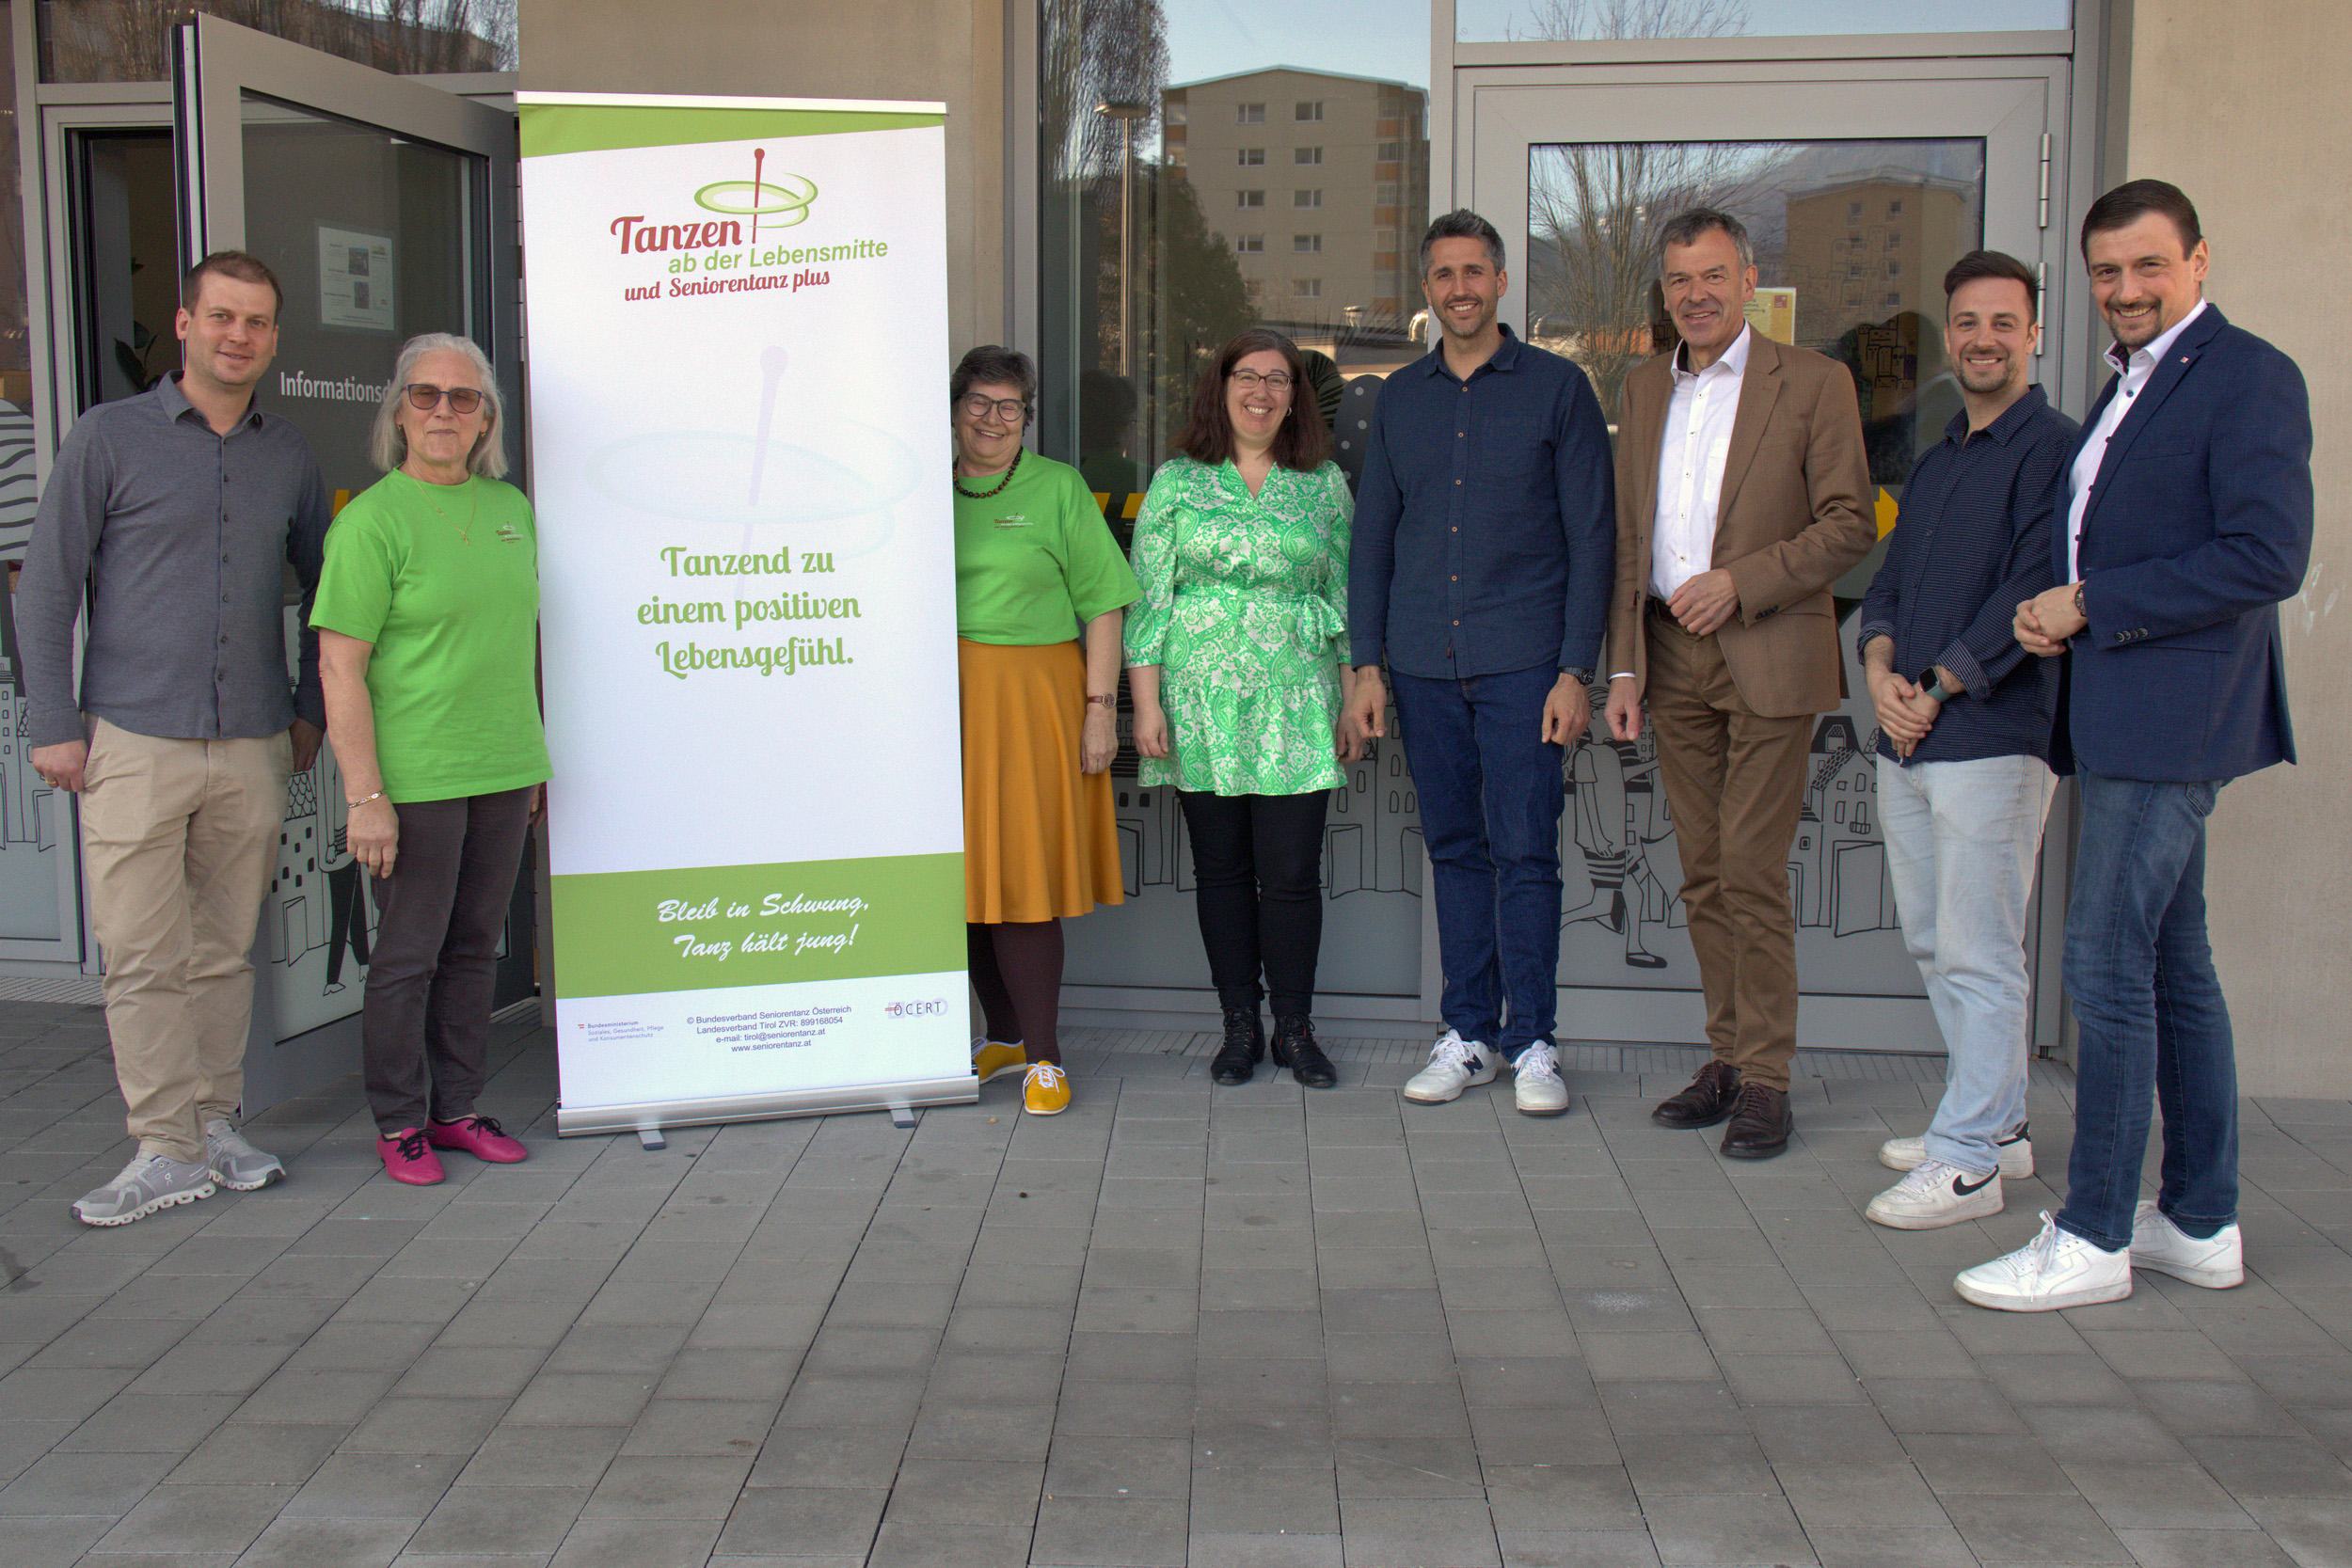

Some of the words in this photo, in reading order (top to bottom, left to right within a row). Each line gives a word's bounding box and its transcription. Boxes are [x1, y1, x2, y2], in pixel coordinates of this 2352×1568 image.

[611, 215, 742, 254] Tanzen
[668, 252, 697, 274] ab
[705, 250, 742, 271] der
[749, 239, 888, 267] Lebensmitte
[625, 281, 660, 301] und
[669, 274, 788, 297] Seniorentanz
[792, 269, 830, 293] plus
[660, 546, 791, 577] Tanzend
[801, 552, 835, 574] zu
[637, 595, 726, 625] einem
[735, 591, 862, 631] positiven
[655, 636, 853, 680] Lebensgefühl.
[657, 896, 719, 922] Bleib
[726, 901, 751, 918] in
[759, 893, 868, 918] Schwung,
[673, 934, 733, 961] Tanz
[740, 931, 788, 953] hält
[794, 923, 859, 956] jung!
[696, 1012, 757, 1024] Bundesverband
[759, 1008, 810, 1019] Seniorentanz
[812, 1006, 851, 1016] Österreich
[894, 1001, 942, 1016] ÖCERT
[599, 1032, 654, 1041] Konsumentenschutz
[697, 1022, 757, 1034] Landesverband
[759, 1022, 777, 1030] Tirol
[778, 1020, 798, 1028] ZVR:
[800, 1016, 843, 1027] 899168054
[716, 1034, 742, 1043] e-mail:
[744, 1029, 825, 1041] tirol@seniorentanz.at
[731, 1039, 812, 1053] www.seniorentanz.at
